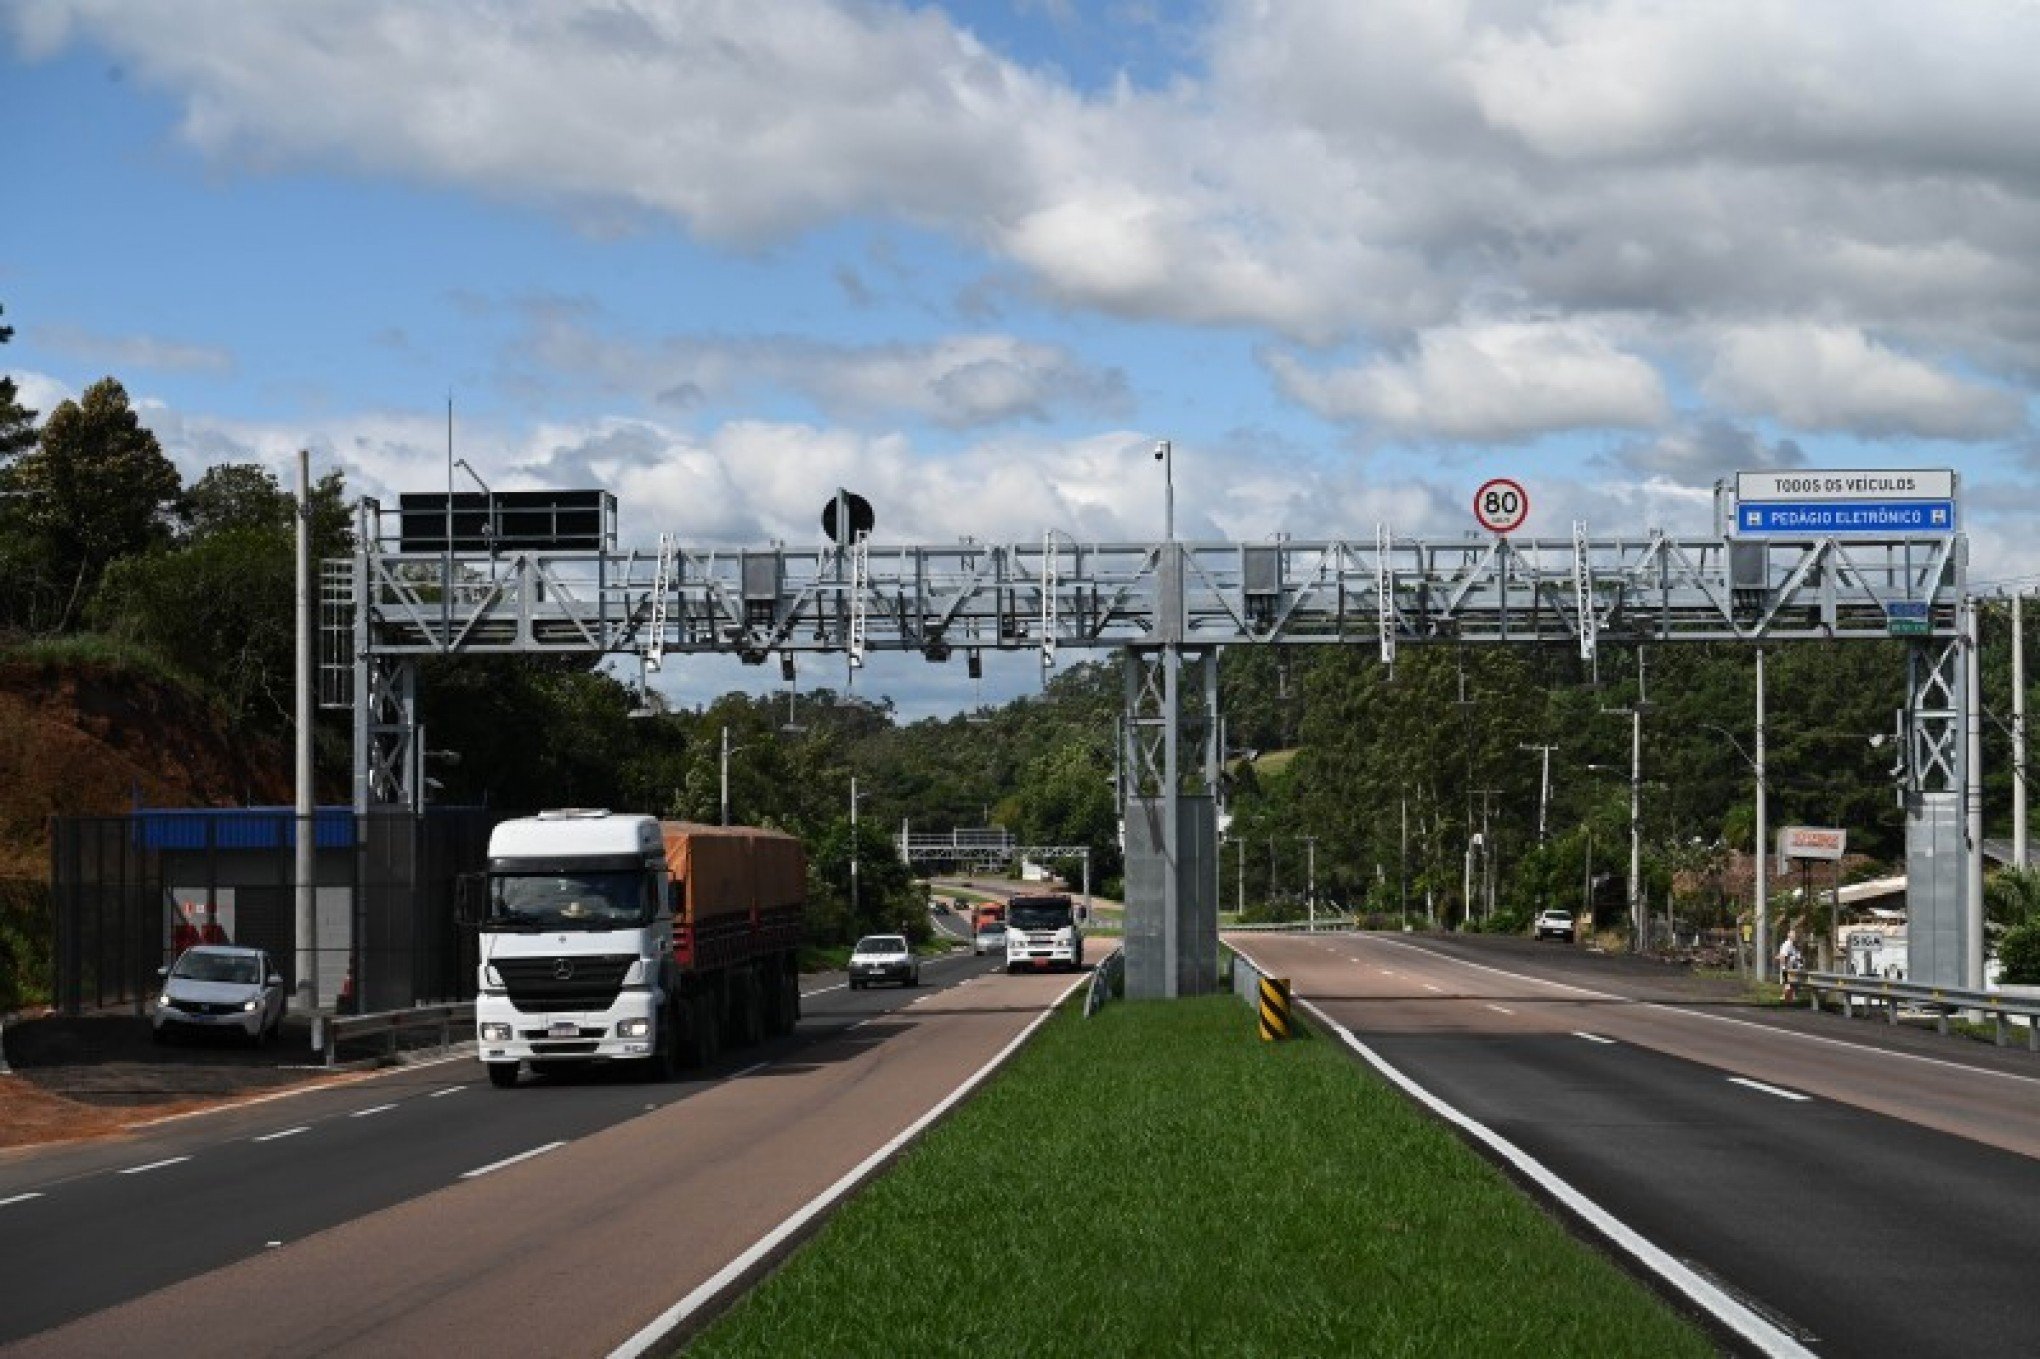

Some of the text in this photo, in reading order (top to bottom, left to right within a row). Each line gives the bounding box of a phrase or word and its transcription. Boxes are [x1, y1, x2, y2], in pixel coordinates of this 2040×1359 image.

[1775, 474, 1916, 493] TODOS OS VEÍCULOS
[1484, 492, 1517, 515] 80
[1771, 507, 1921, 526] PEDÁGIO ELETRÔNICO
